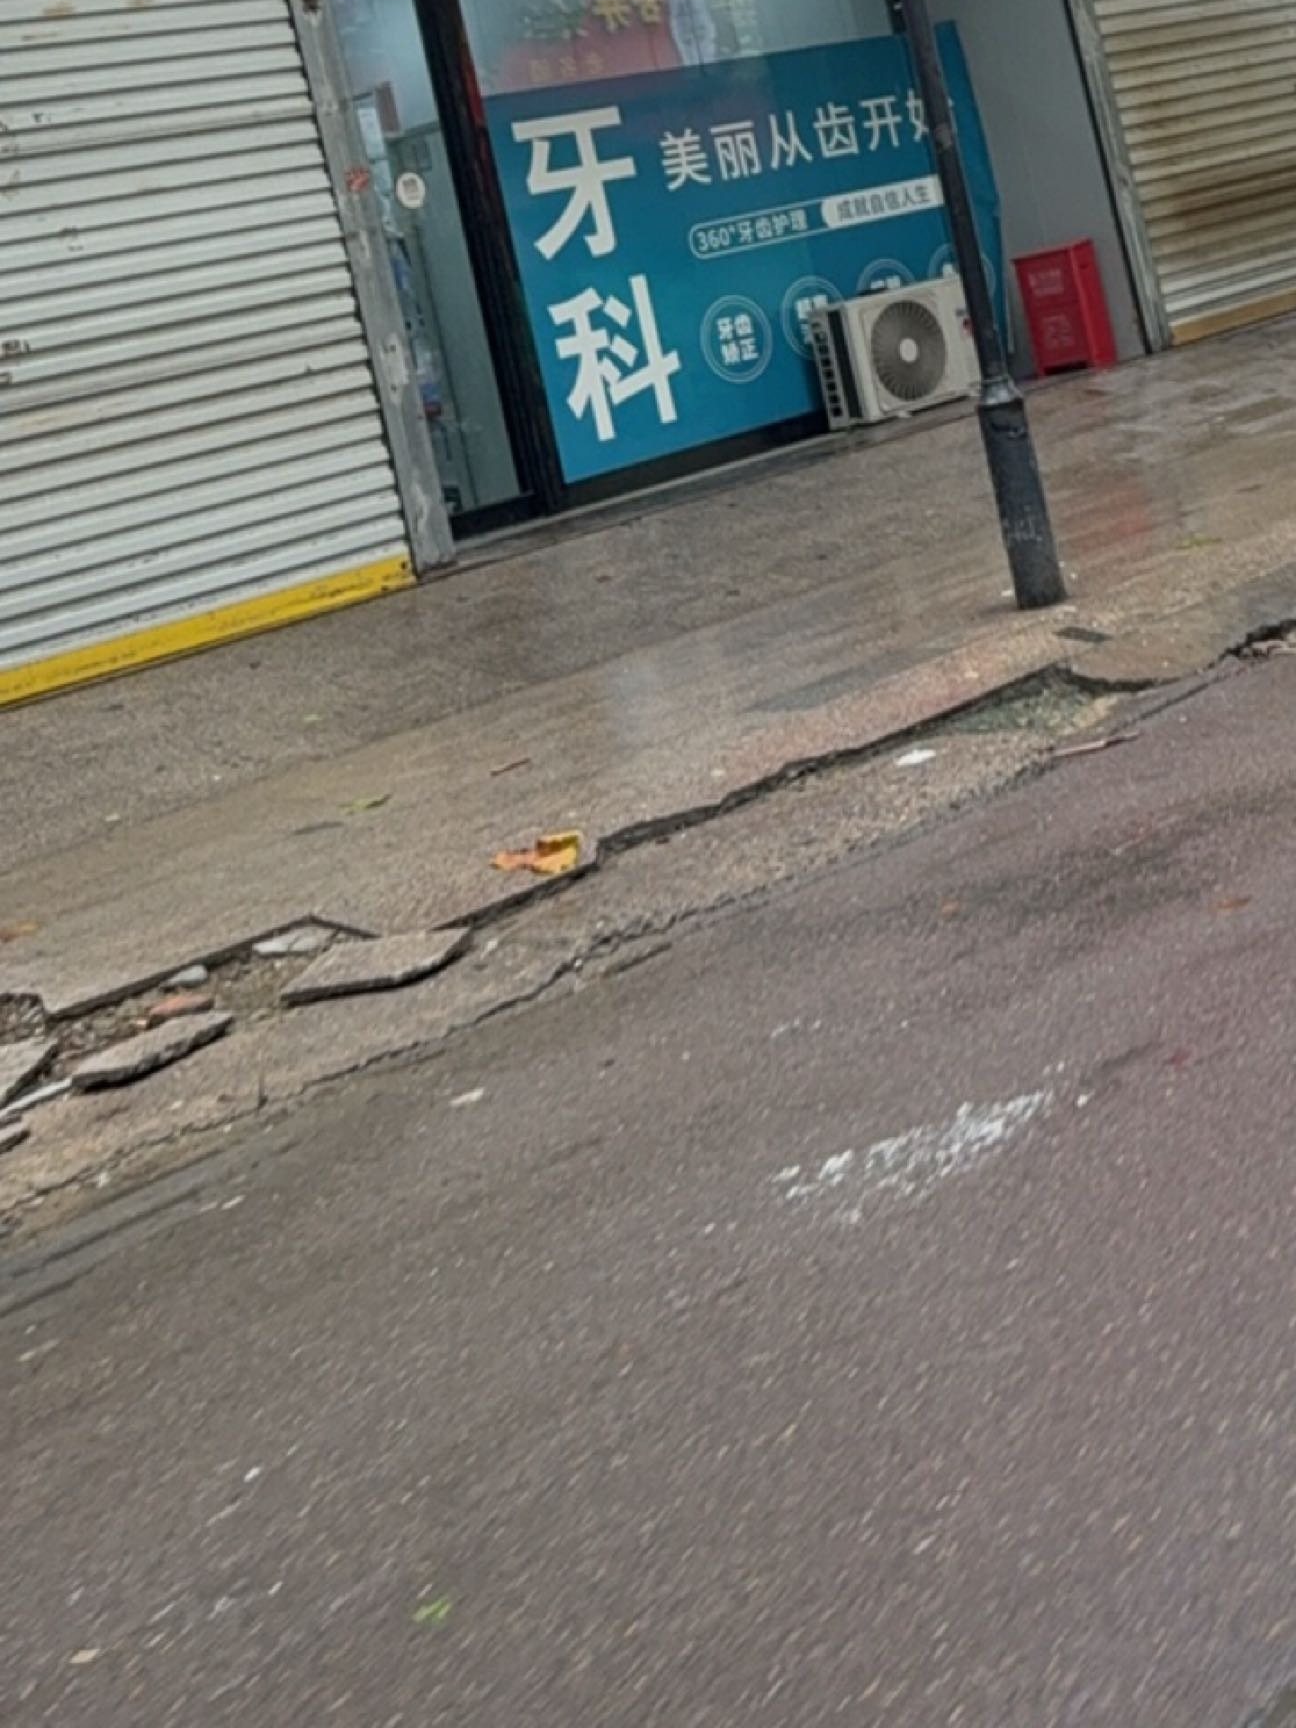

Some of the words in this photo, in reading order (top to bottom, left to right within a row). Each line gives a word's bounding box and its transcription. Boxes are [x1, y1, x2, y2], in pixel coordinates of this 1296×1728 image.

[837, 183, 930, 222] 成就自信人生
[697, 208, 808, 252] 360°牙齿护理
[511, 105, 681, 441] 牙科
